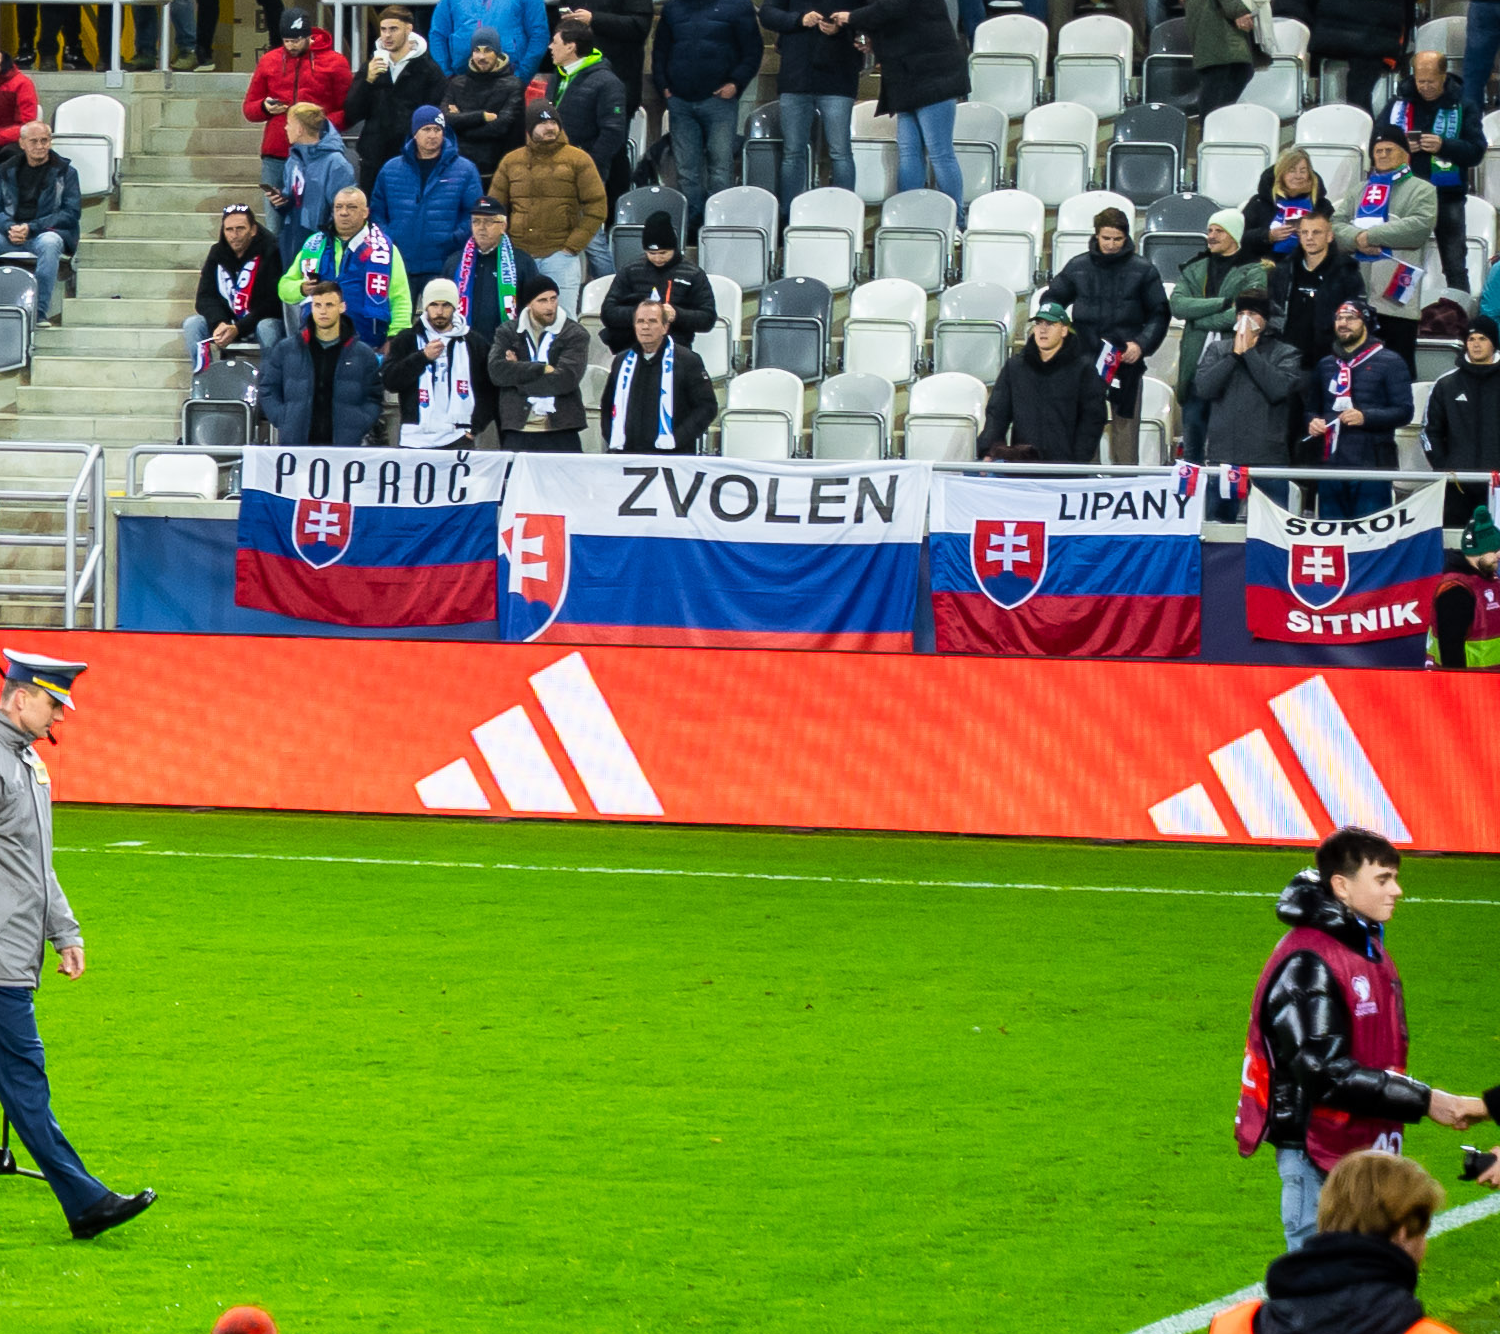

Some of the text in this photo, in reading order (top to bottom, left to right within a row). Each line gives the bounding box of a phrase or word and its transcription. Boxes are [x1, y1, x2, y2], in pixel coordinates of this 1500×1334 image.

[275, 449, 473, 505] POPROČ
[617, 466, 898, 525] ZVOLEN
[1057, 489, 1193, 522] LIPANY
[1284, 507, 1417, 537] SOKOL
[1285, 600, 1423, 635] SITNIK
